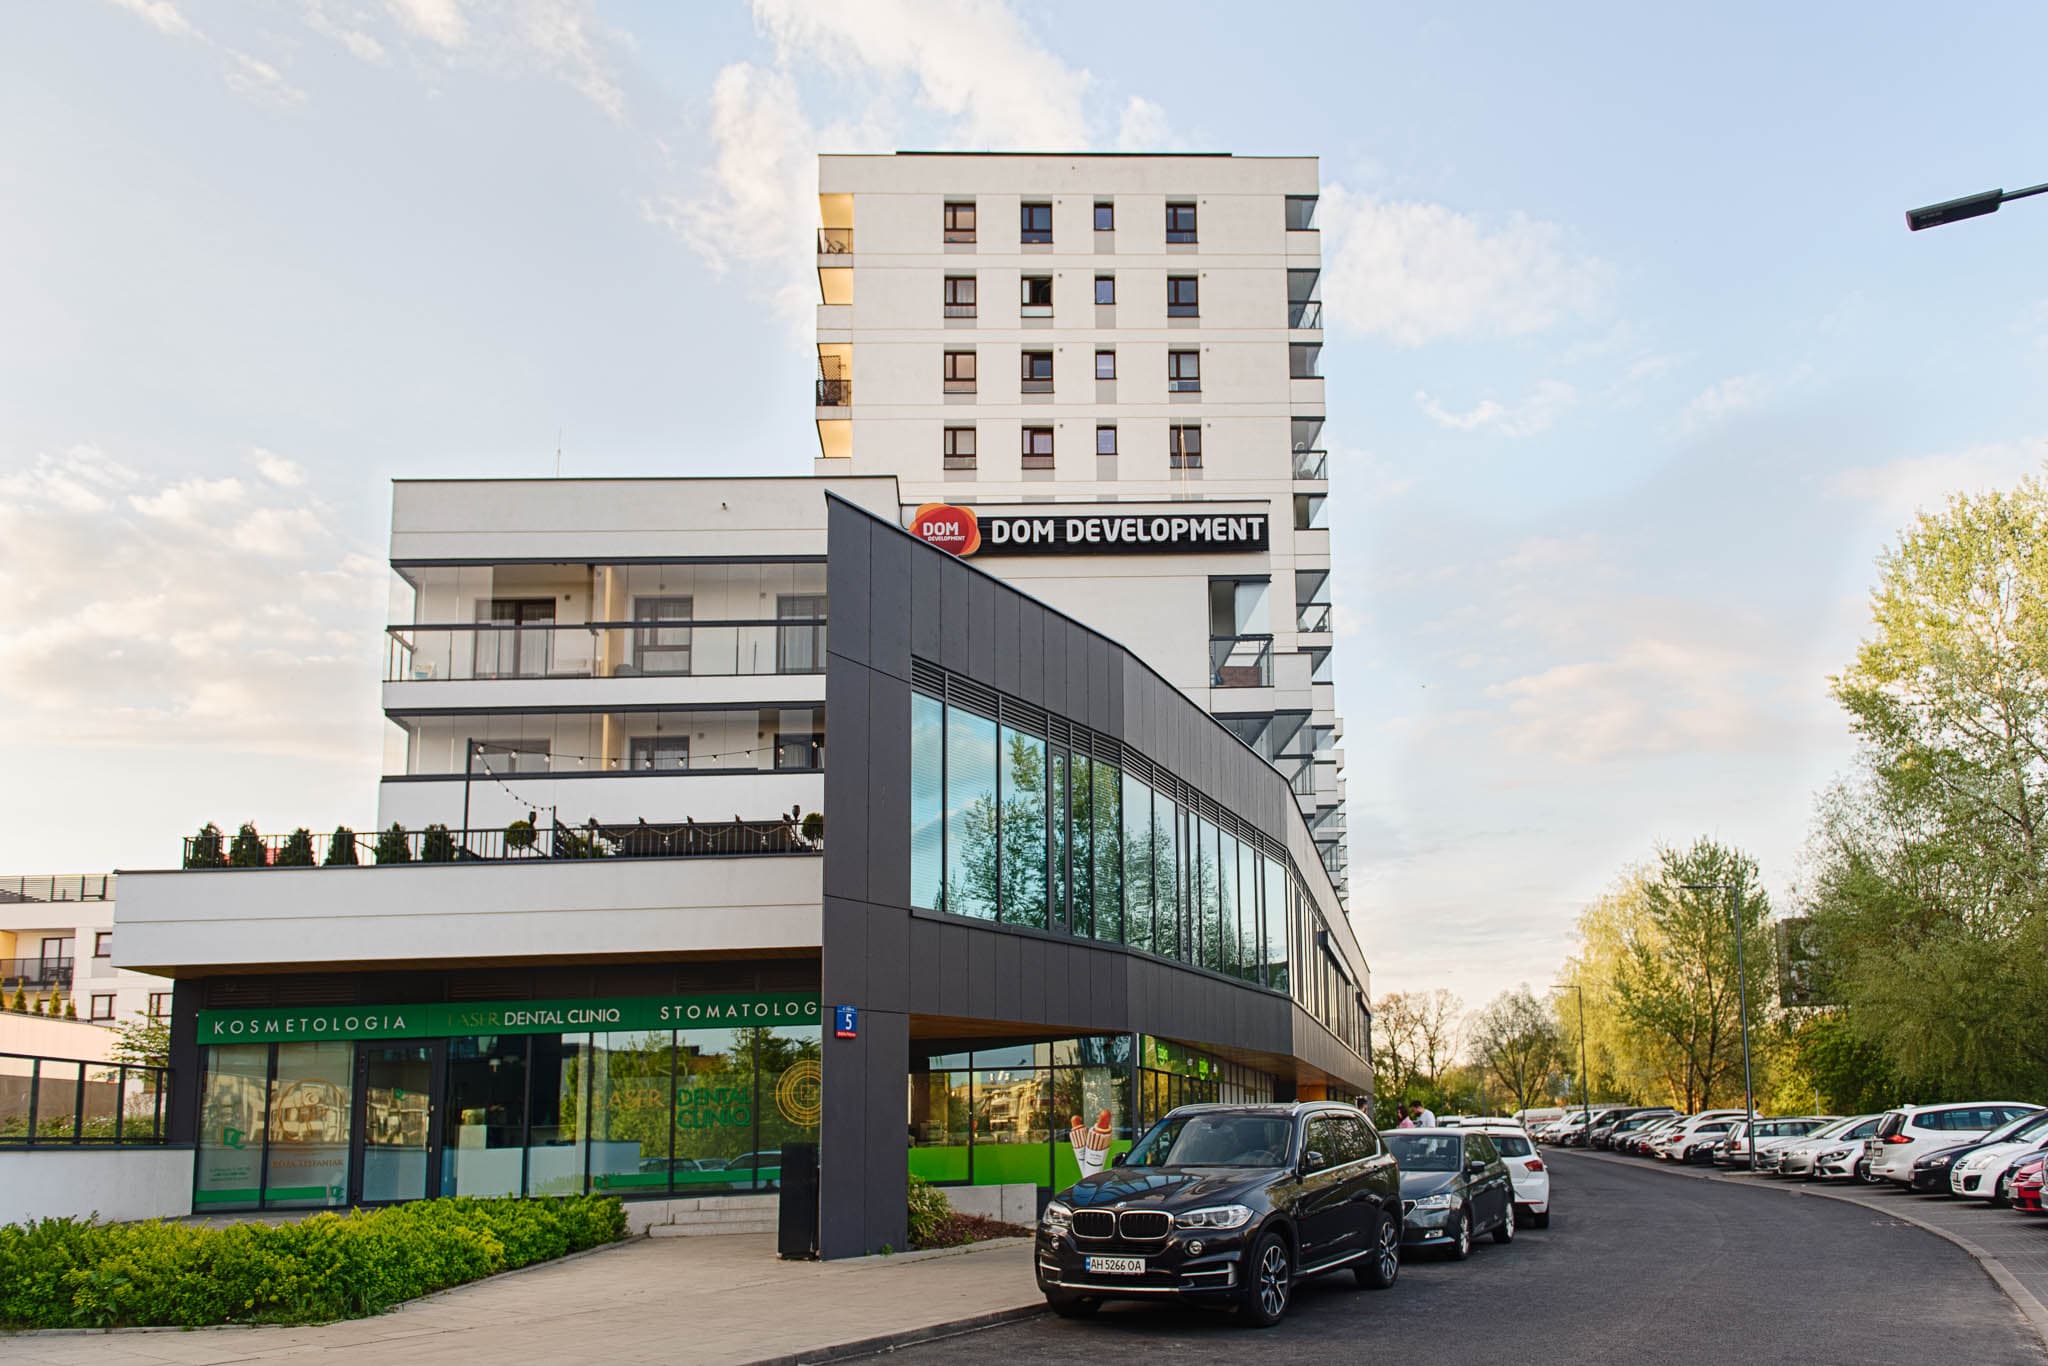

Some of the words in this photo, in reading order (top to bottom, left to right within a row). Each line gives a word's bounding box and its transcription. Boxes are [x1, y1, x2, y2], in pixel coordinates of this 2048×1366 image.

[922, 521, 959, 536] DOM
[991, 519, 1055, 543] DOM
[1066, 517, 1265, 542] DEVELOPMENT
[213, 1015, 406, 1035] KOSMETOLOGIA
[504, 1010, 564, 1026] DENTAL
[567, 1008, 621, 1024] CLINIQ
[845, 1013, 853, 1030] 5
[677, 1087, 752, 1107] DENTAL
[677, 1107, 751, 1128] CLINIQ
[1091, 1259, 1103, 1270] AH
[1105, 1259, 1126, 1271] 5266
[1127, 1260, 1142, 1271] OA
